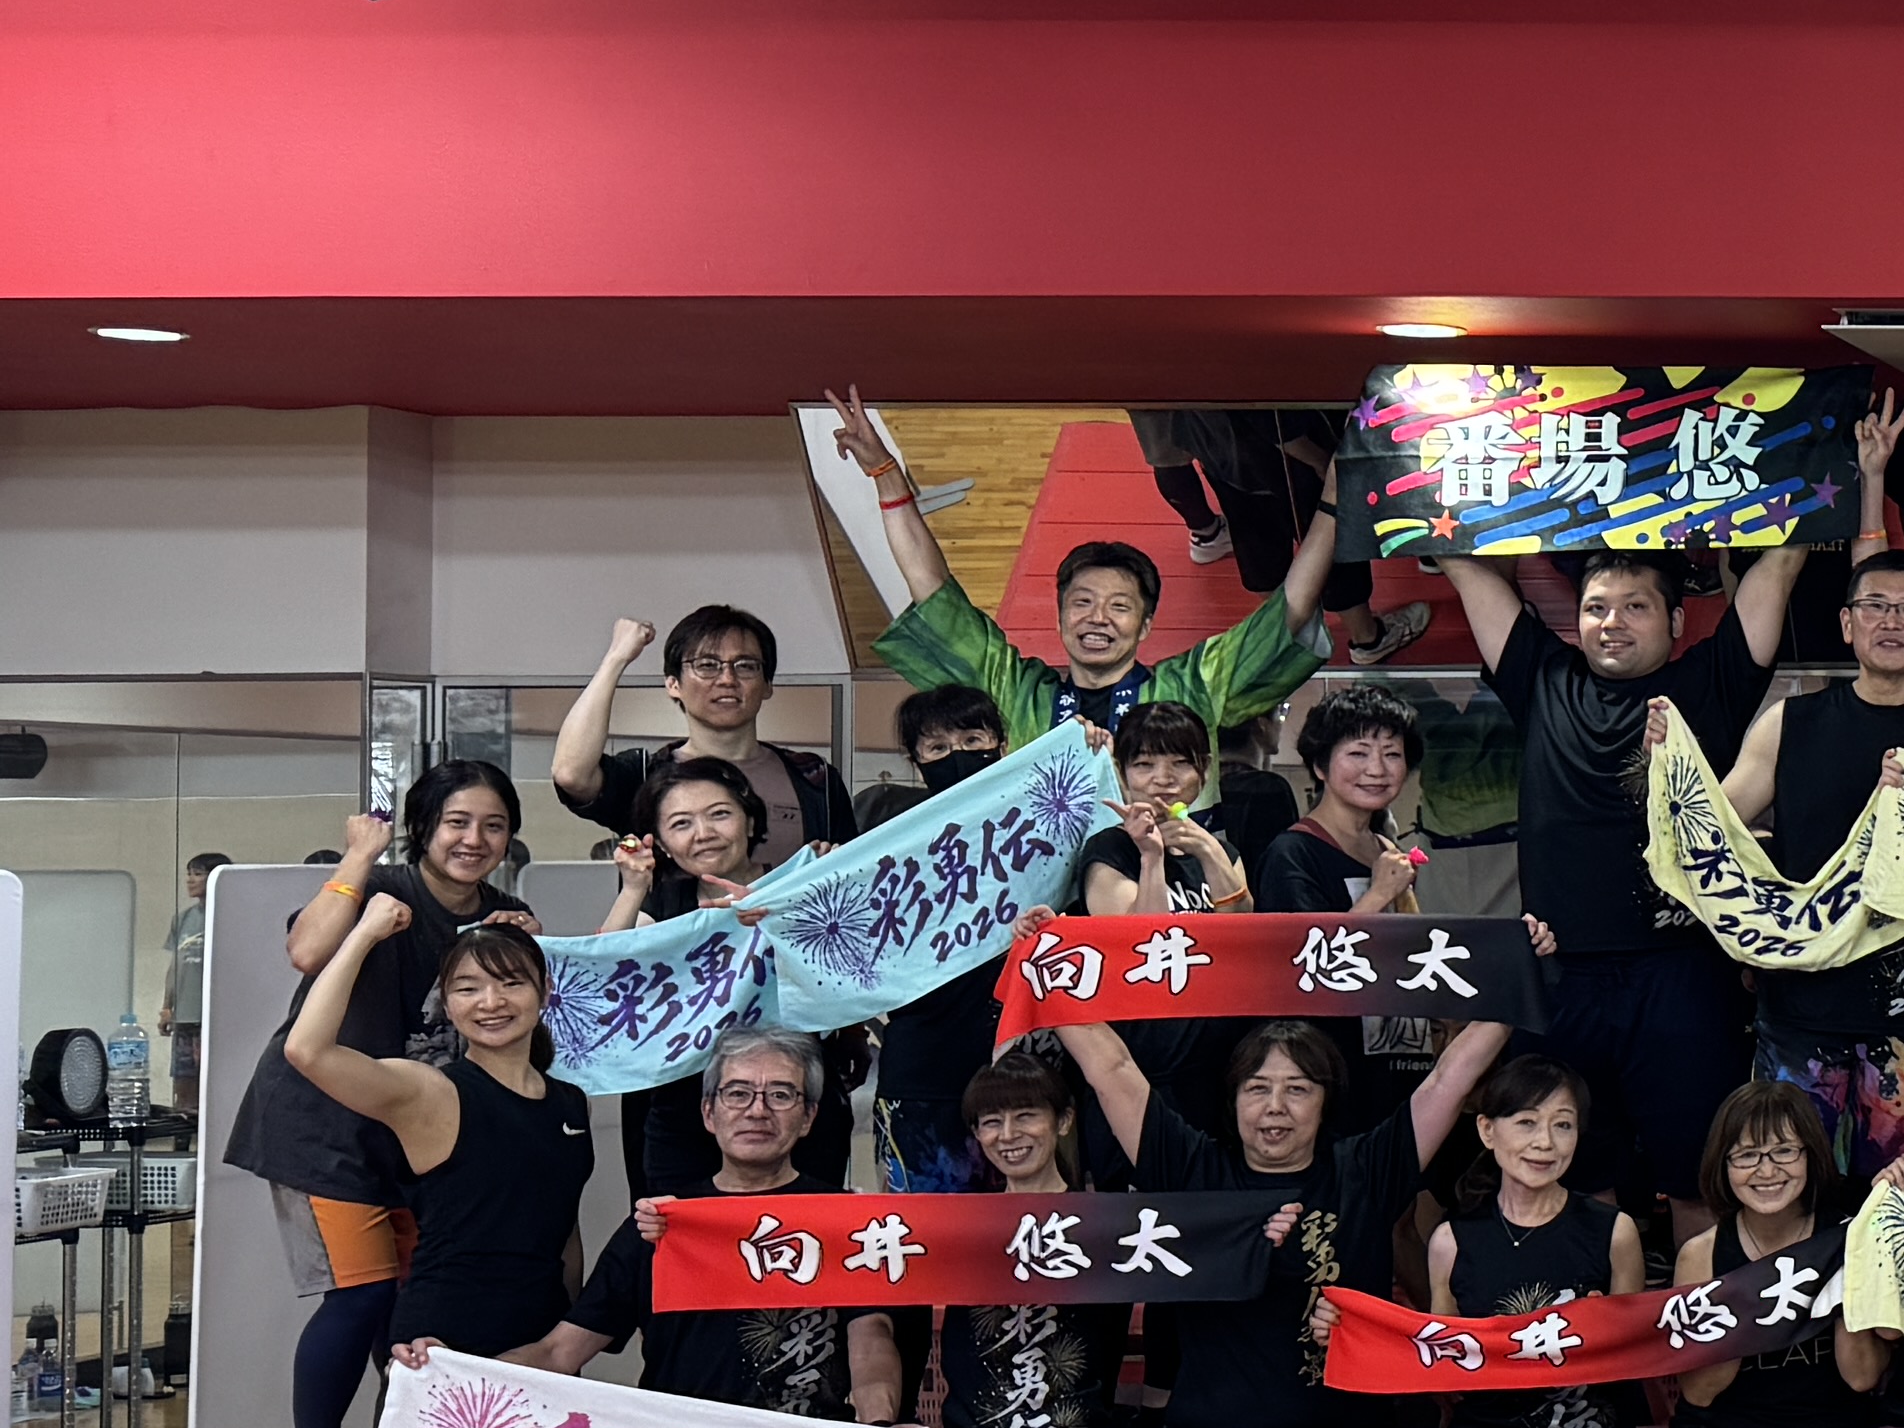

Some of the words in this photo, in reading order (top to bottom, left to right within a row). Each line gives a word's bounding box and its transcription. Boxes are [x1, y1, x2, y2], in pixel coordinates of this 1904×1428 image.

[1429, 409, 1629, 508] 番場
[1668, 407, 1765, 494] 悠
[869, 806, 1056, 956] 彩勇伝
[1653, 909, 1702, 929] 202
[930, 889, 1019, 963] 2026
[1022, 925, 1212, 1003] 向井
[1294, 925, 1480, 1000] 悠太
[1714, 913, 1813, 957] 2026
[739, 1212, 926, 1285] 向井
[1006, 1207, 1194, 1282] 悠太
[1408, 1312, 1582, 1372] 向井
[1656, 1257, 1822, 1350] 悠太
